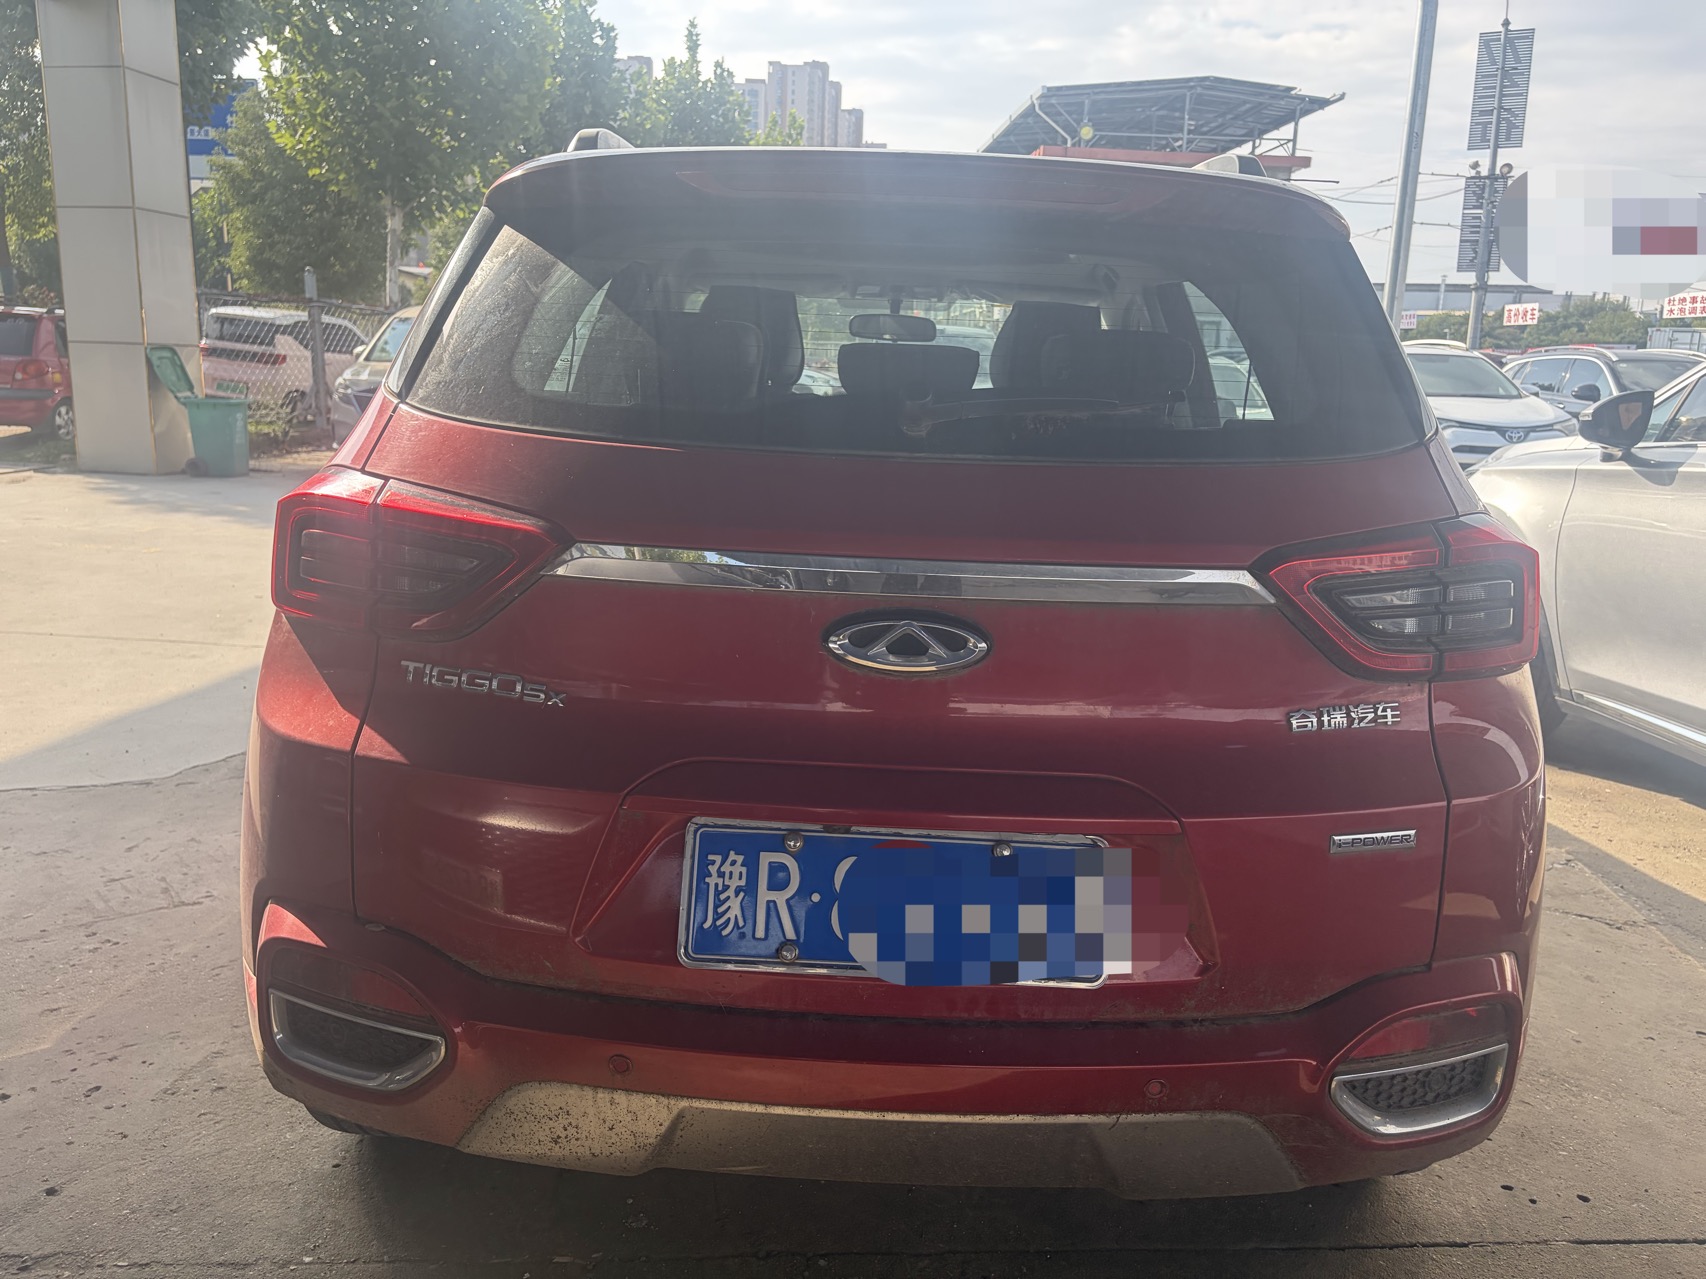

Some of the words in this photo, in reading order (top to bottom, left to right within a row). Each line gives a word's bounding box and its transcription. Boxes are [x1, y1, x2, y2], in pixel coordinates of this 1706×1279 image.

[1505, 307, 1537, 324] 高价收车
[1290, 702, 1401, 732] 奇瑞汽车
